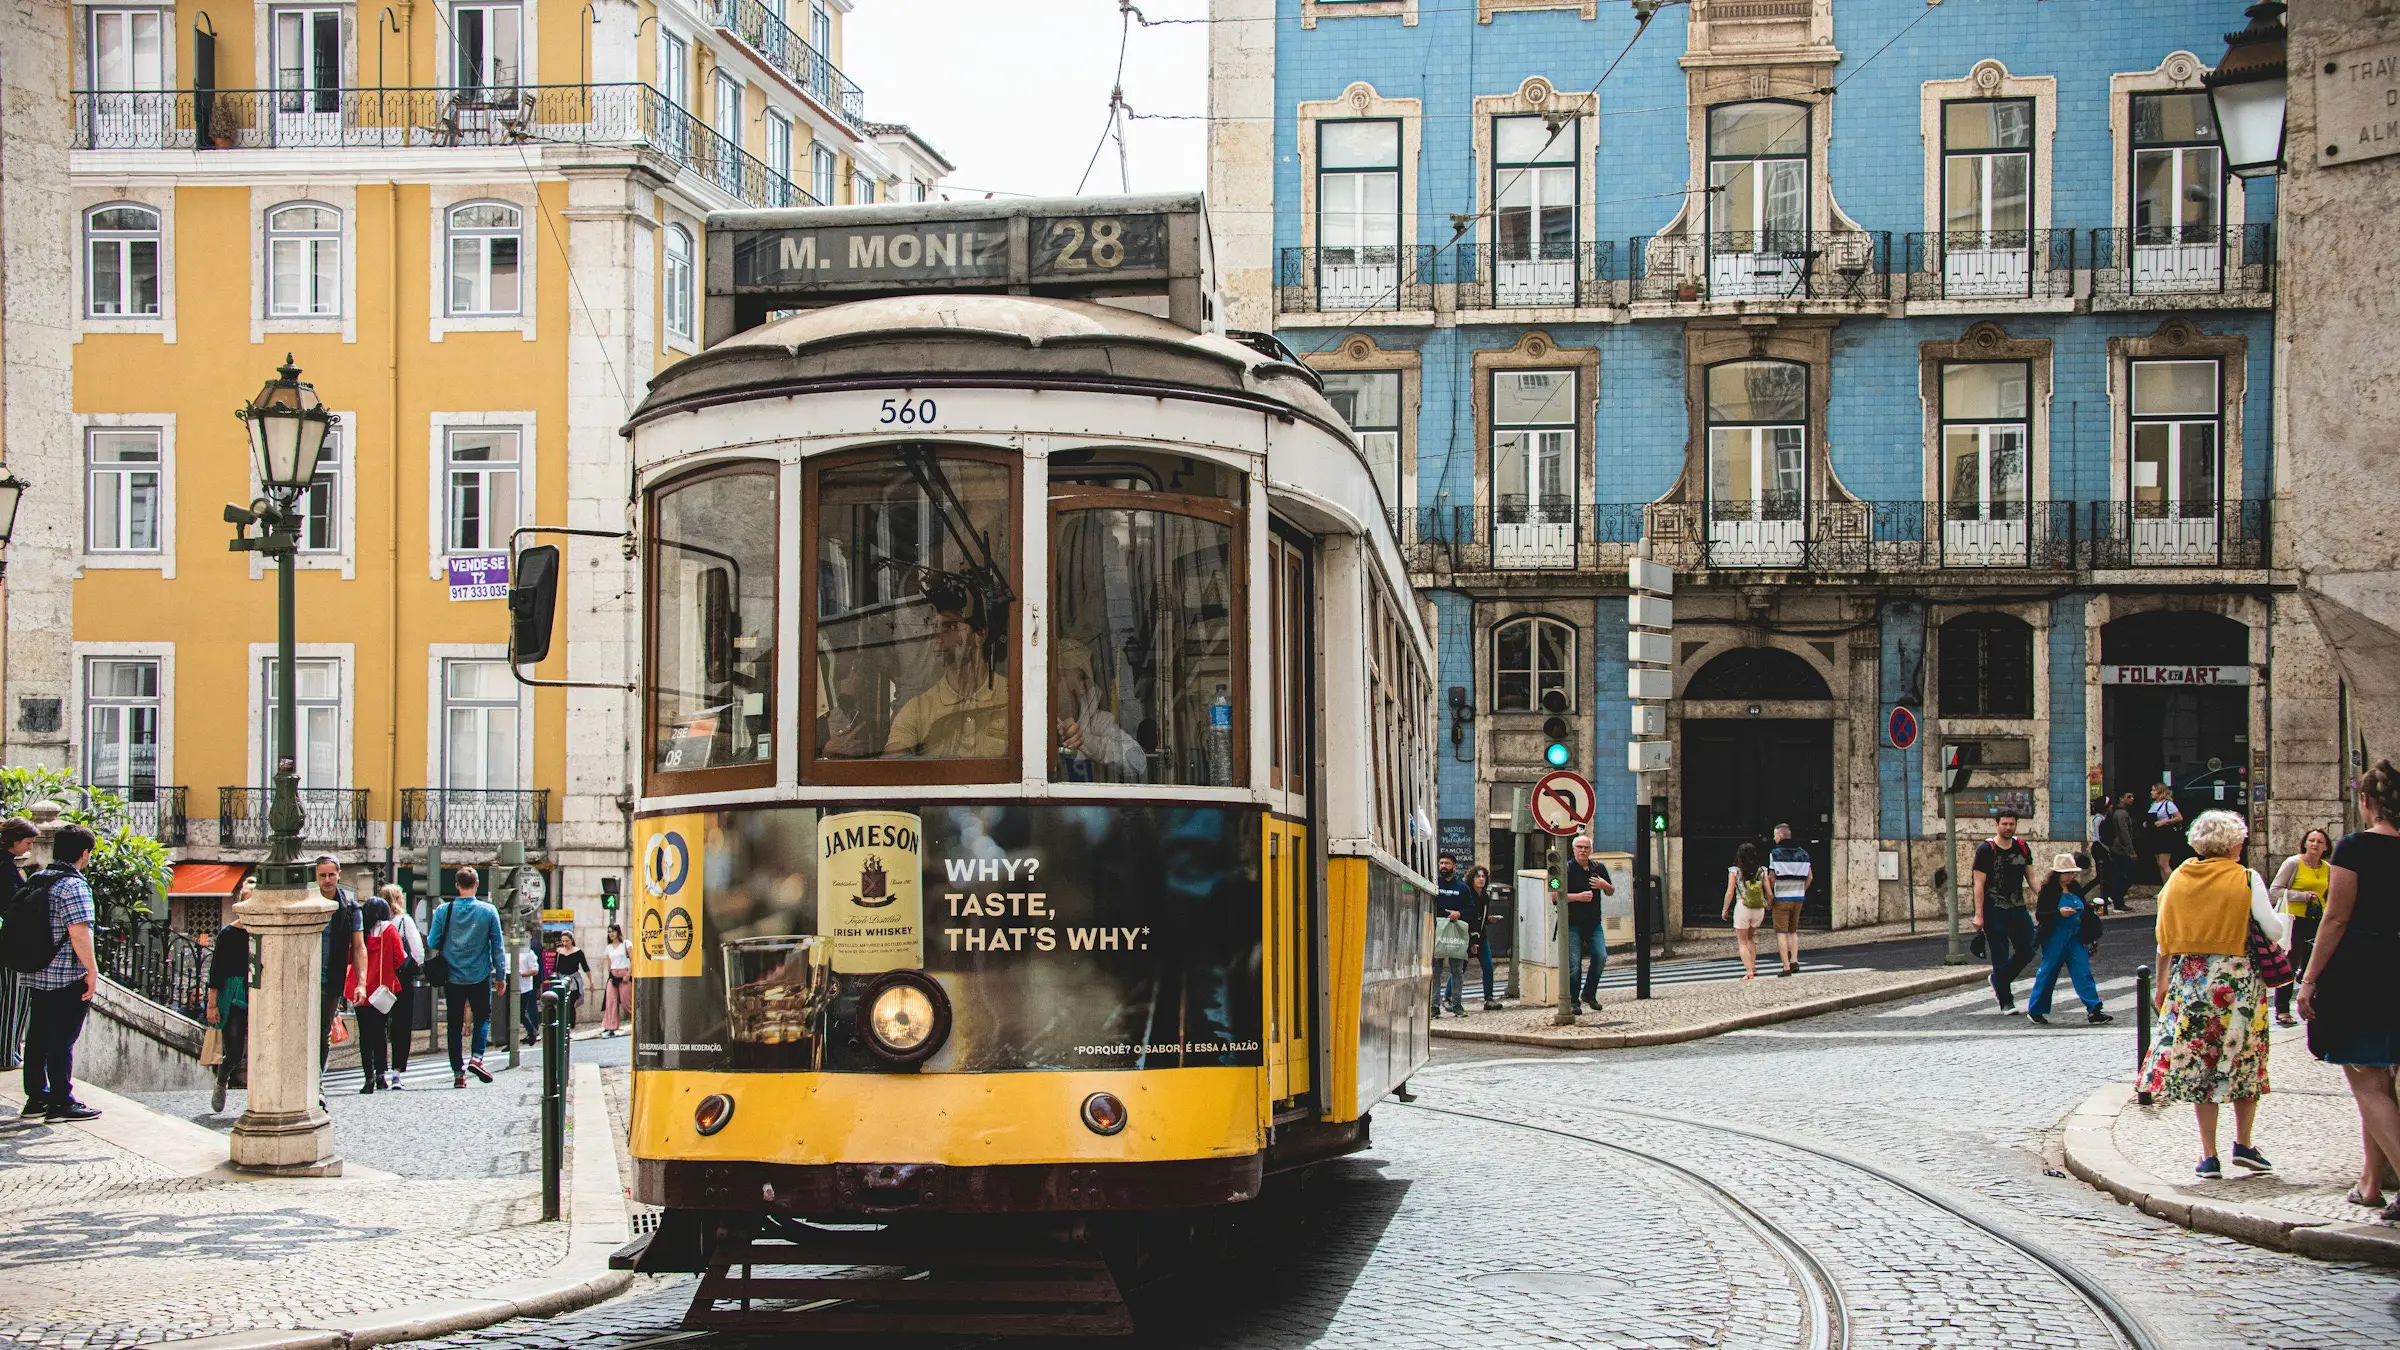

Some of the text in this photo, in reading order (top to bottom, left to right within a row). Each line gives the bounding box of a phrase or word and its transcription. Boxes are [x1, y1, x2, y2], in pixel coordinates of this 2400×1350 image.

[2348, 56, 2397, 81] TRAV
[2359, 120, 2398, 144] ALM
[779, 232, 1008, 270] M. MONIZ
[1052, 219, 1125, 269] 28
[880, 398, 937, 424] 560
[451, 557, 505, 572] VENDE-SE
[471, 572, 486, 584] T2
[452, 585, 508, 599] 917 333 035
[2118, 667, 2220, 684] FOLK ART
[2170, 671, 2181, 680] 87
[671, 728, 689, 740] 28E
[665, 749, 683, 767] 08
[825, 825, 919, 858] JAMESON
[944, 857, 1040, 882] WHY?
[944, 892, 1056, 921] TASTE,
[834, 926, 913, 937] IRISH WHISKEY
[944, 926, 1057, 952] THAT'S
[680, 1043, 690, 1051] COM
[691, 1042, 723, 1053] MODERAÇÃO.
[1133, 1044, 1142, 1054] O
[1185, 1041, 1192, 1053] É
[1194, 1043, 1219, 1053] ESSA
[1221, 1042, 1228, 1052] A
[1229, 1039, 1259, 1051] RAZÃO
